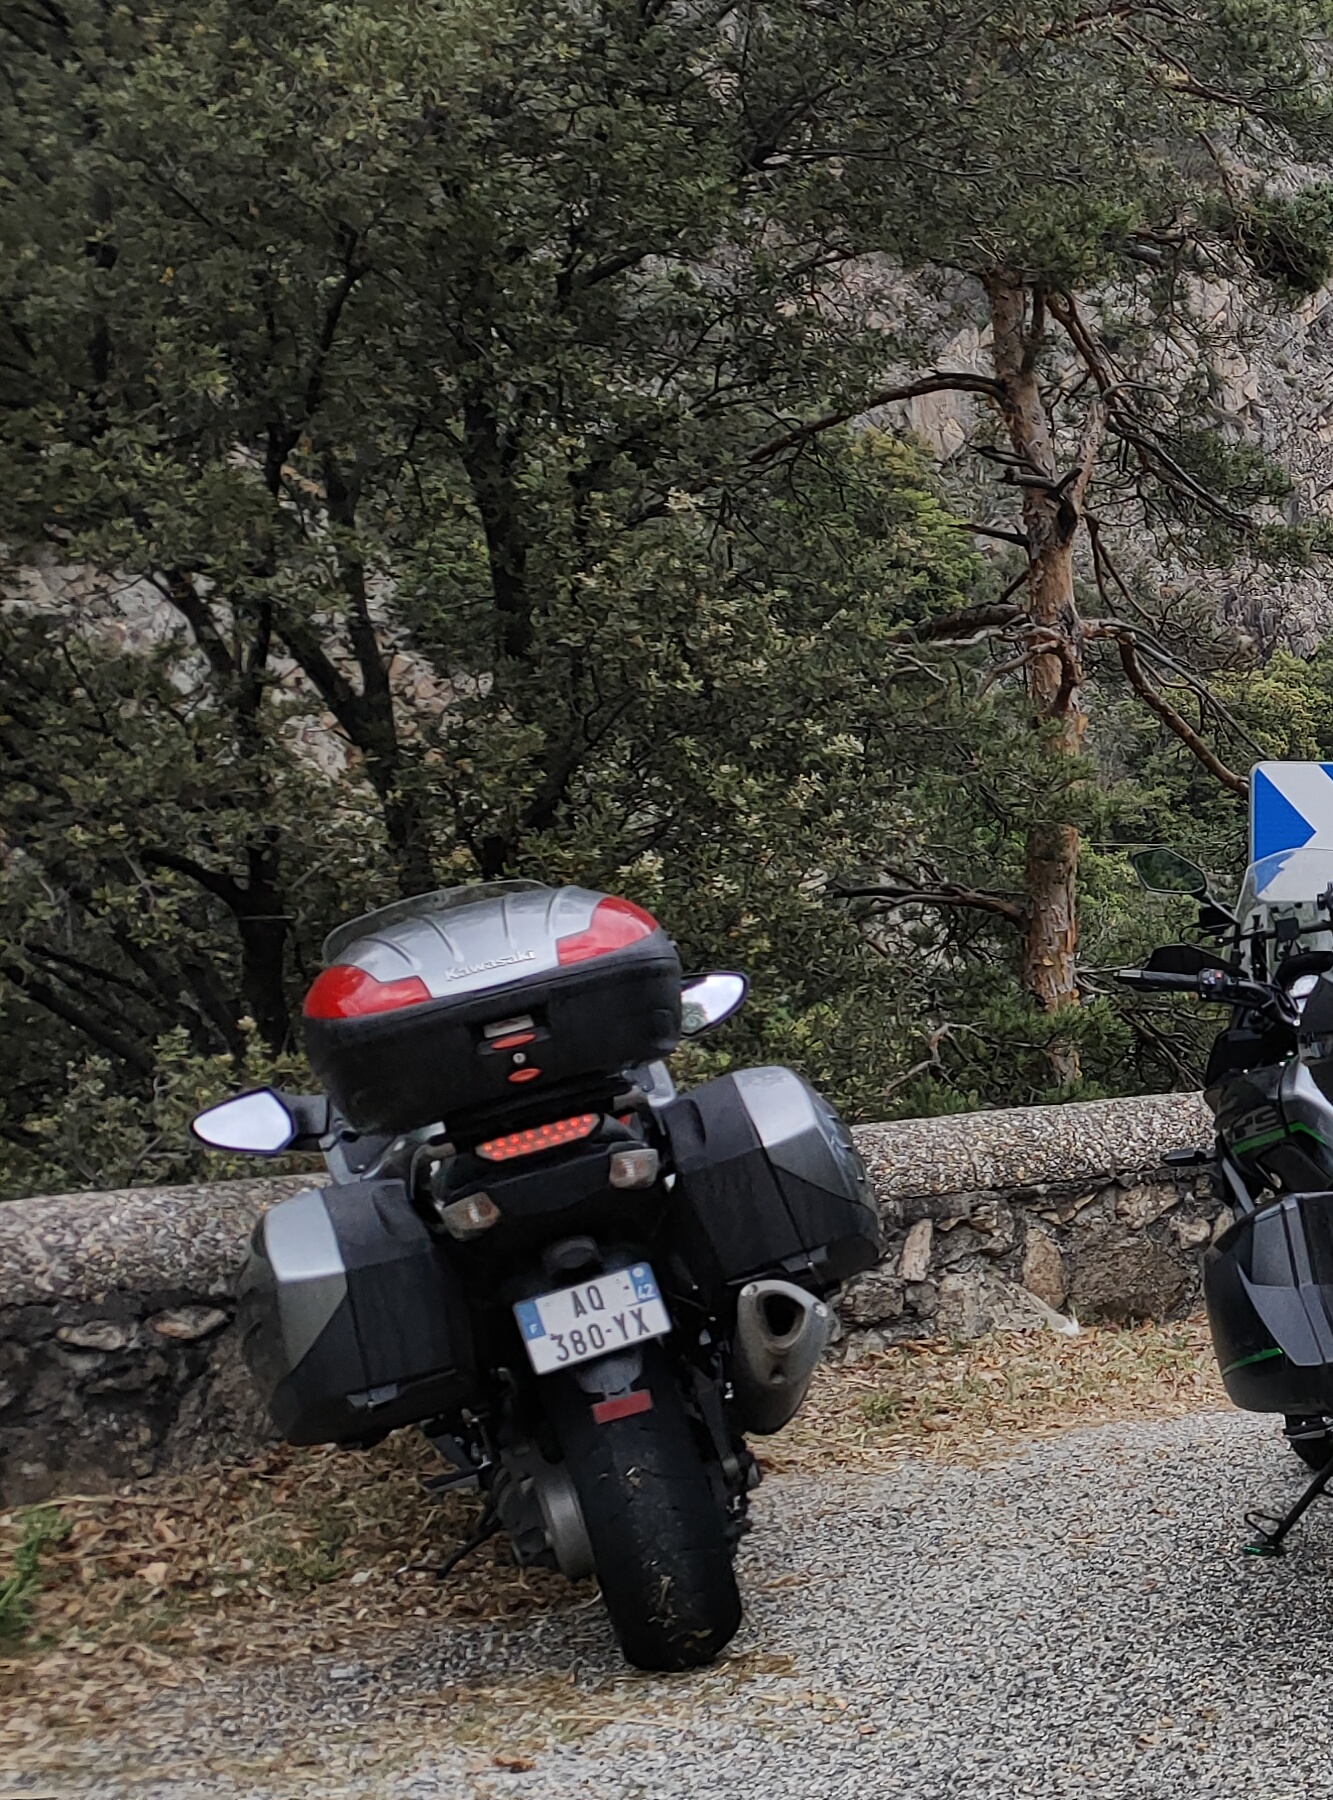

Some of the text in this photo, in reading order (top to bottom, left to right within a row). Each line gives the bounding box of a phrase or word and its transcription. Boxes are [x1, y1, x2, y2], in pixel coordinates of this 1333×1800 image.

[444, 949, 535, 981] Kawasaki
[570, 1284, 606, 1318] AQ
[637, 1283, 655, 1300] 42
[550, 1306, 650, 1362] 380-YX
